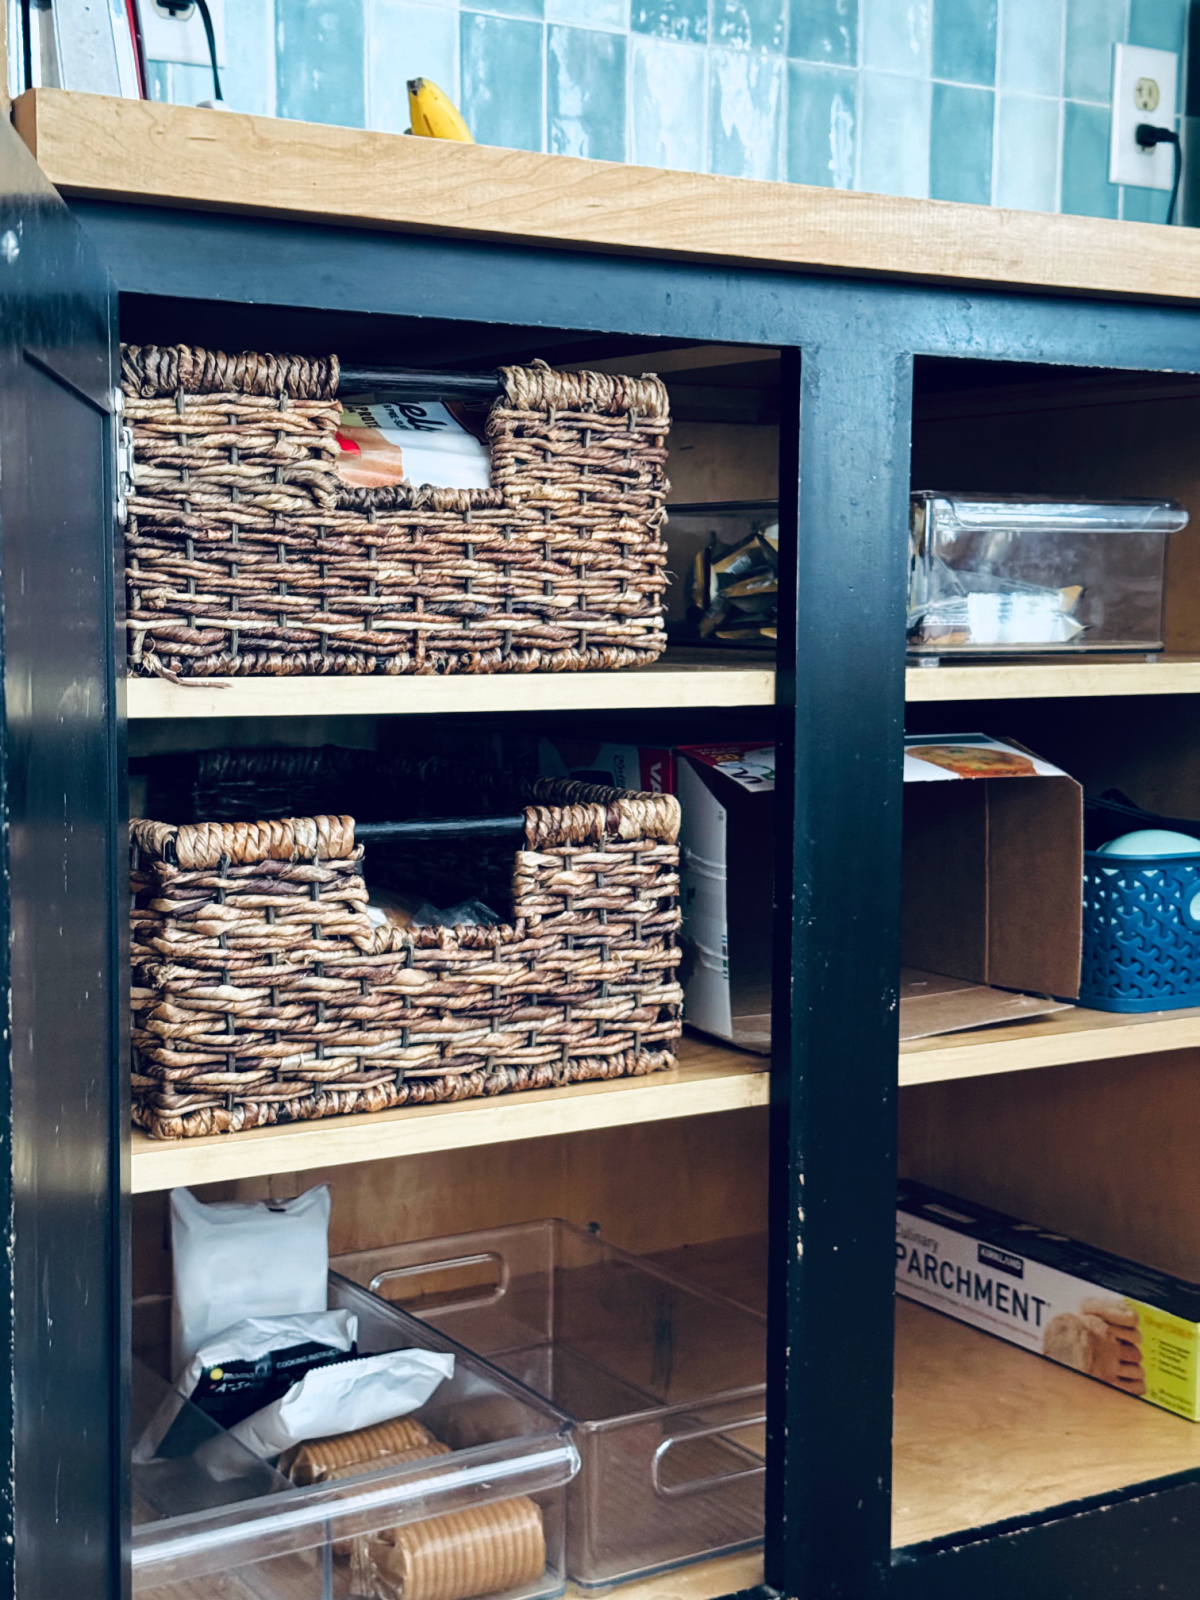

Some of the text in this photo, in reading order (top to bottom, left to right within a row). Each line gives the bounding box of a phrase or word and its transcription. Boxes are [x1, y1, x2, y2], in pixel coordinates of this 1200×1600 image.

[395, 402, 447, 432] els
[896, 1242, 1046, 1327] PARCHMENT
[276, 1356, 308, 1369] COOKING
